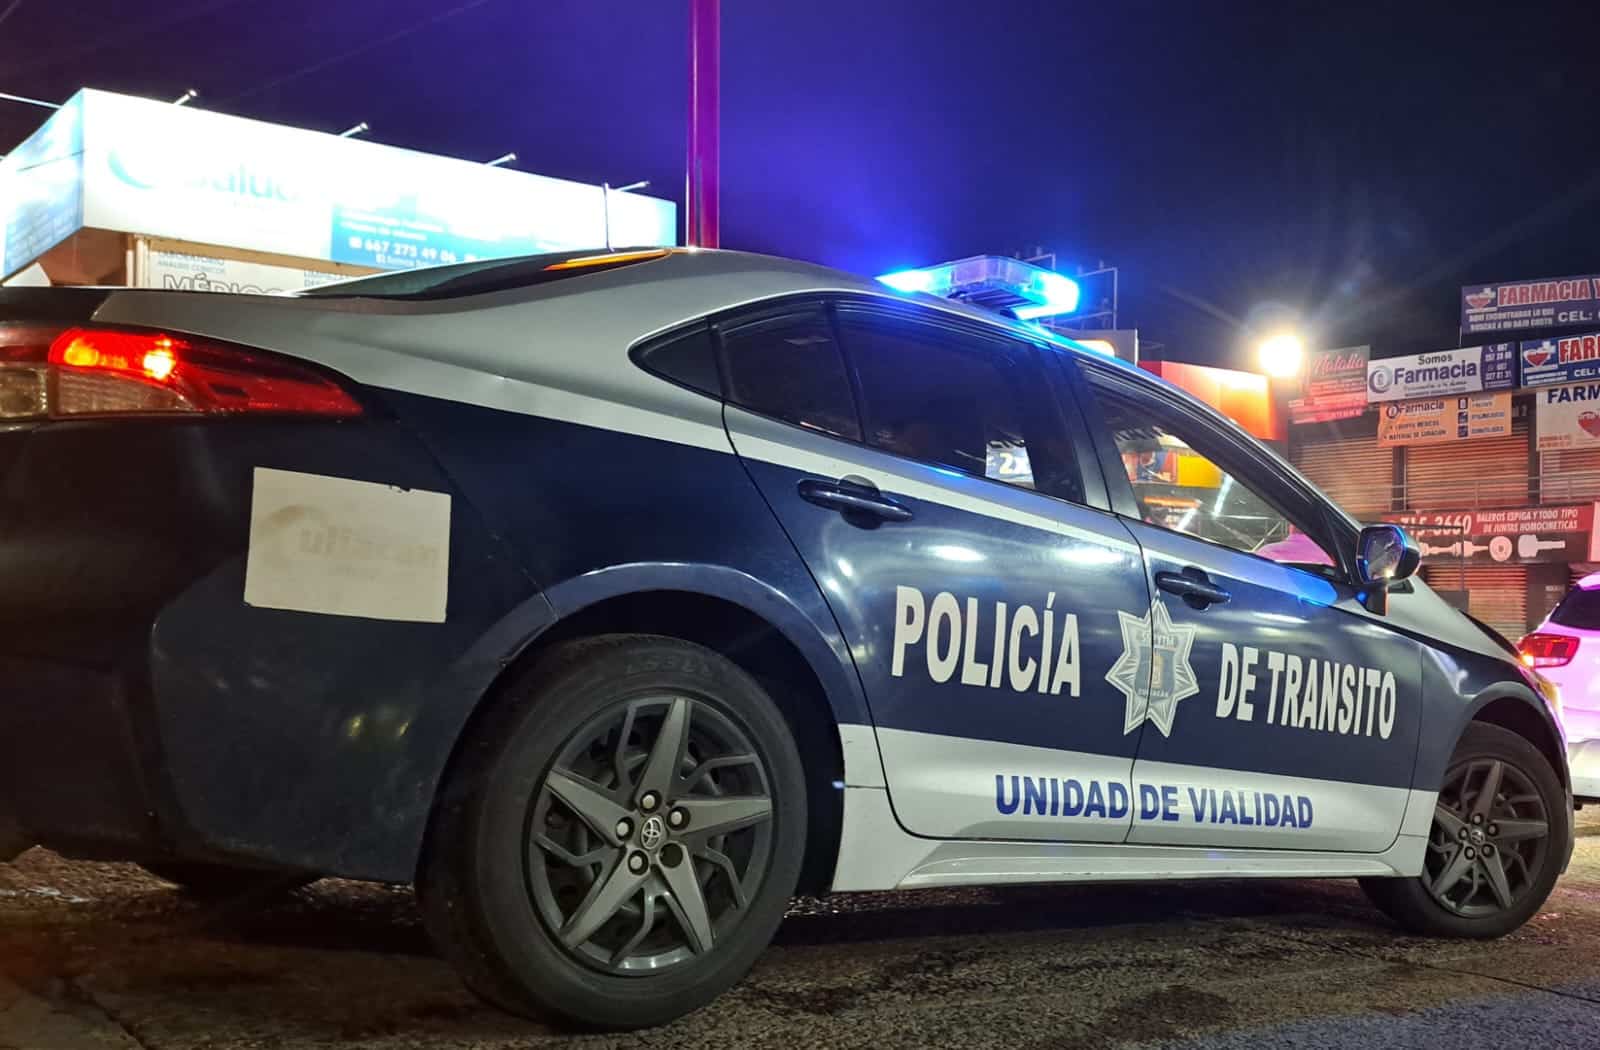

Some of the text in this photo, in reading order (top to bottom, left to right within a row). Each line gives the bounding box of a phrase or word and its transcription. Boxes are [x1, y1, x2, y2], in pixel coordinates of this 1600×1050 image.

[1497, 279, 1591, 307] FARMACIA
[1418, 353, 1453, 365] Somos
[1558, 334, 1600, 364] FAR
[1394, 359, 1478, 385] Farmacia
[1399, 400, 1445, 415] Farmacia
[1561, 508, 1578, 519] TIPO
[892, 585, 1080, 697] POLICÍA
[1216, 642, 1396, 739] DE TRANSITO
[995, 774, 1313, 829] UNIDAD DE VIALIDAD
